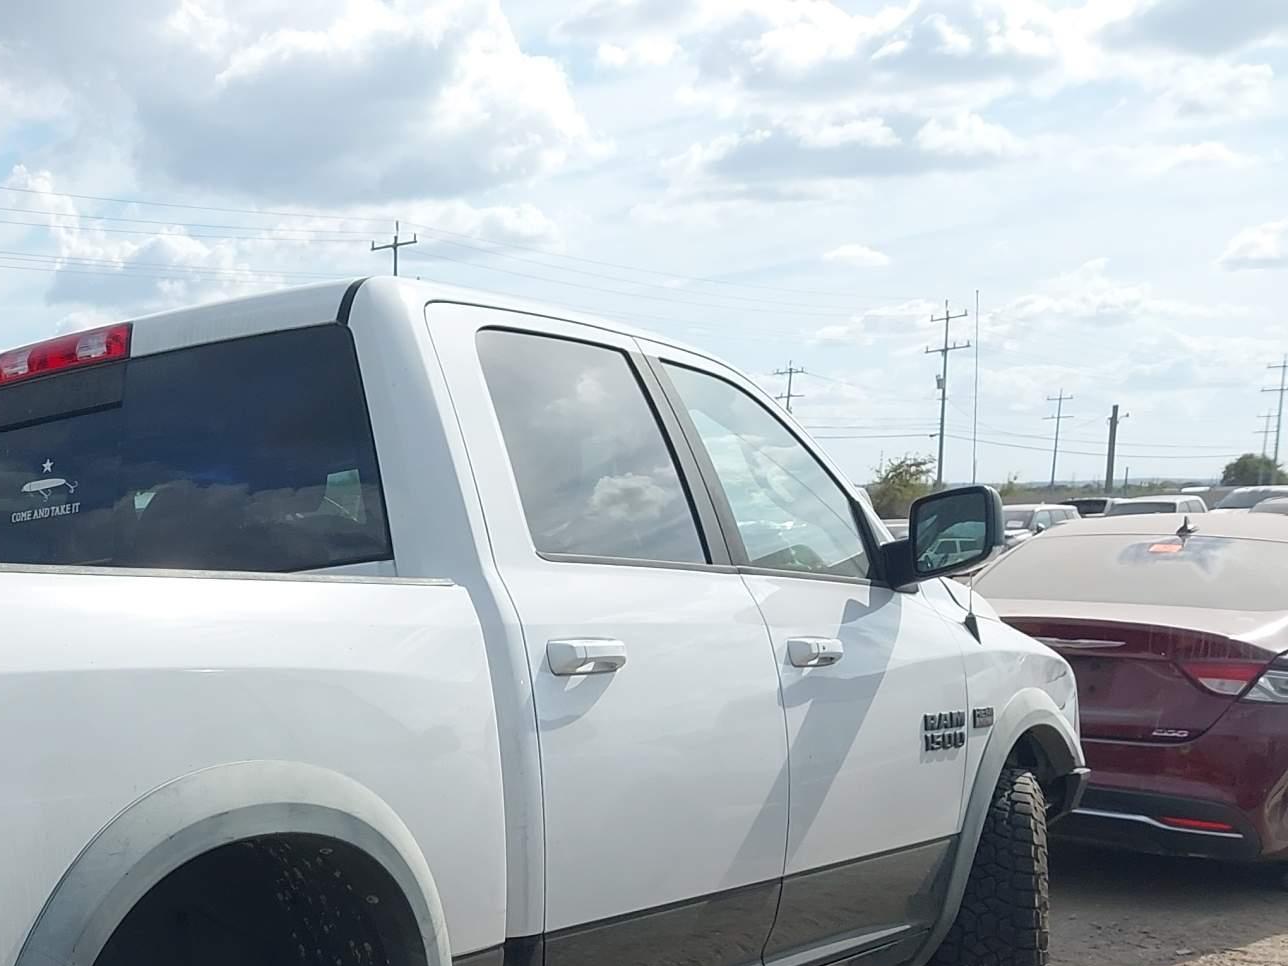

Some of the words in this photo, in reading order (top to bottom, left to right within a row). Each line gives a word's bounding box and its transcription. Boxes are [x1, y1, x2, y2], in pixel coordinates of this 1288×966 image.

[12, 510, 32, 523] COME
[32, 507, 50, 519] AND
[50, 503, 71, 517] TAKE
[71, 502, 81, 513] IT
[923, 710, 965, 731] RAM
[924, 731, 965, 752] 1500
